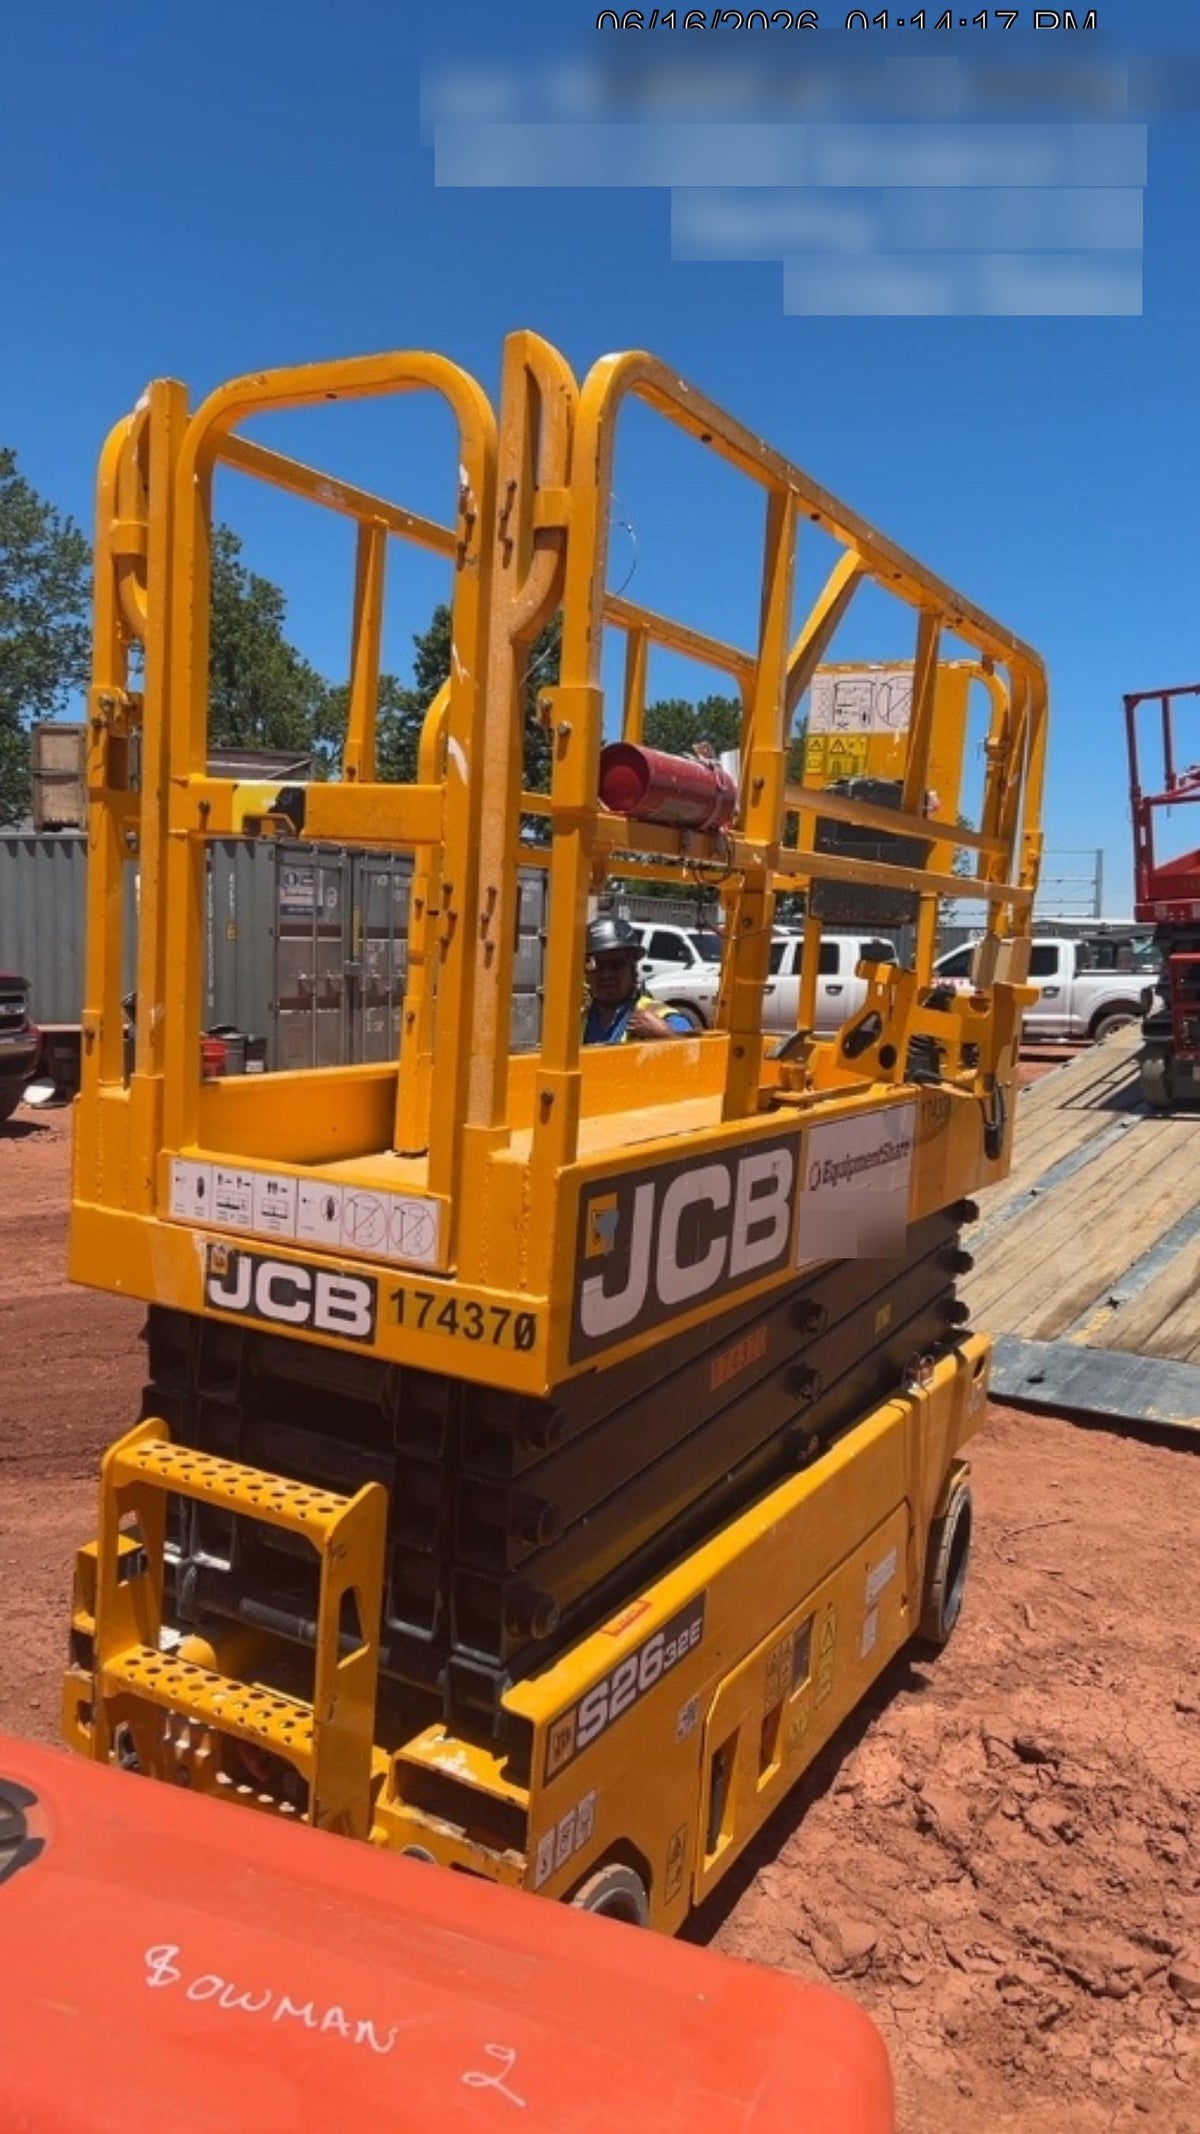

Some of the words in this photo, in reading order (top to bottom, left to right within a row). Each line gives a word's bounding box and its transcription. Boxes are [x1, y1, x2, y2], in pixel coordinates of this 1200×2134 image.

[822, 1140, 910, 1187] EquipmentShare
[208, 1255, 371, 1336] JCB
[390, 1287, 537, 1351] 174370
[580, 1147, 793, 1338] JCB
[144, 1944, 398, 2054] BOWMAN
[461, 2042, 527, 2107] 2
